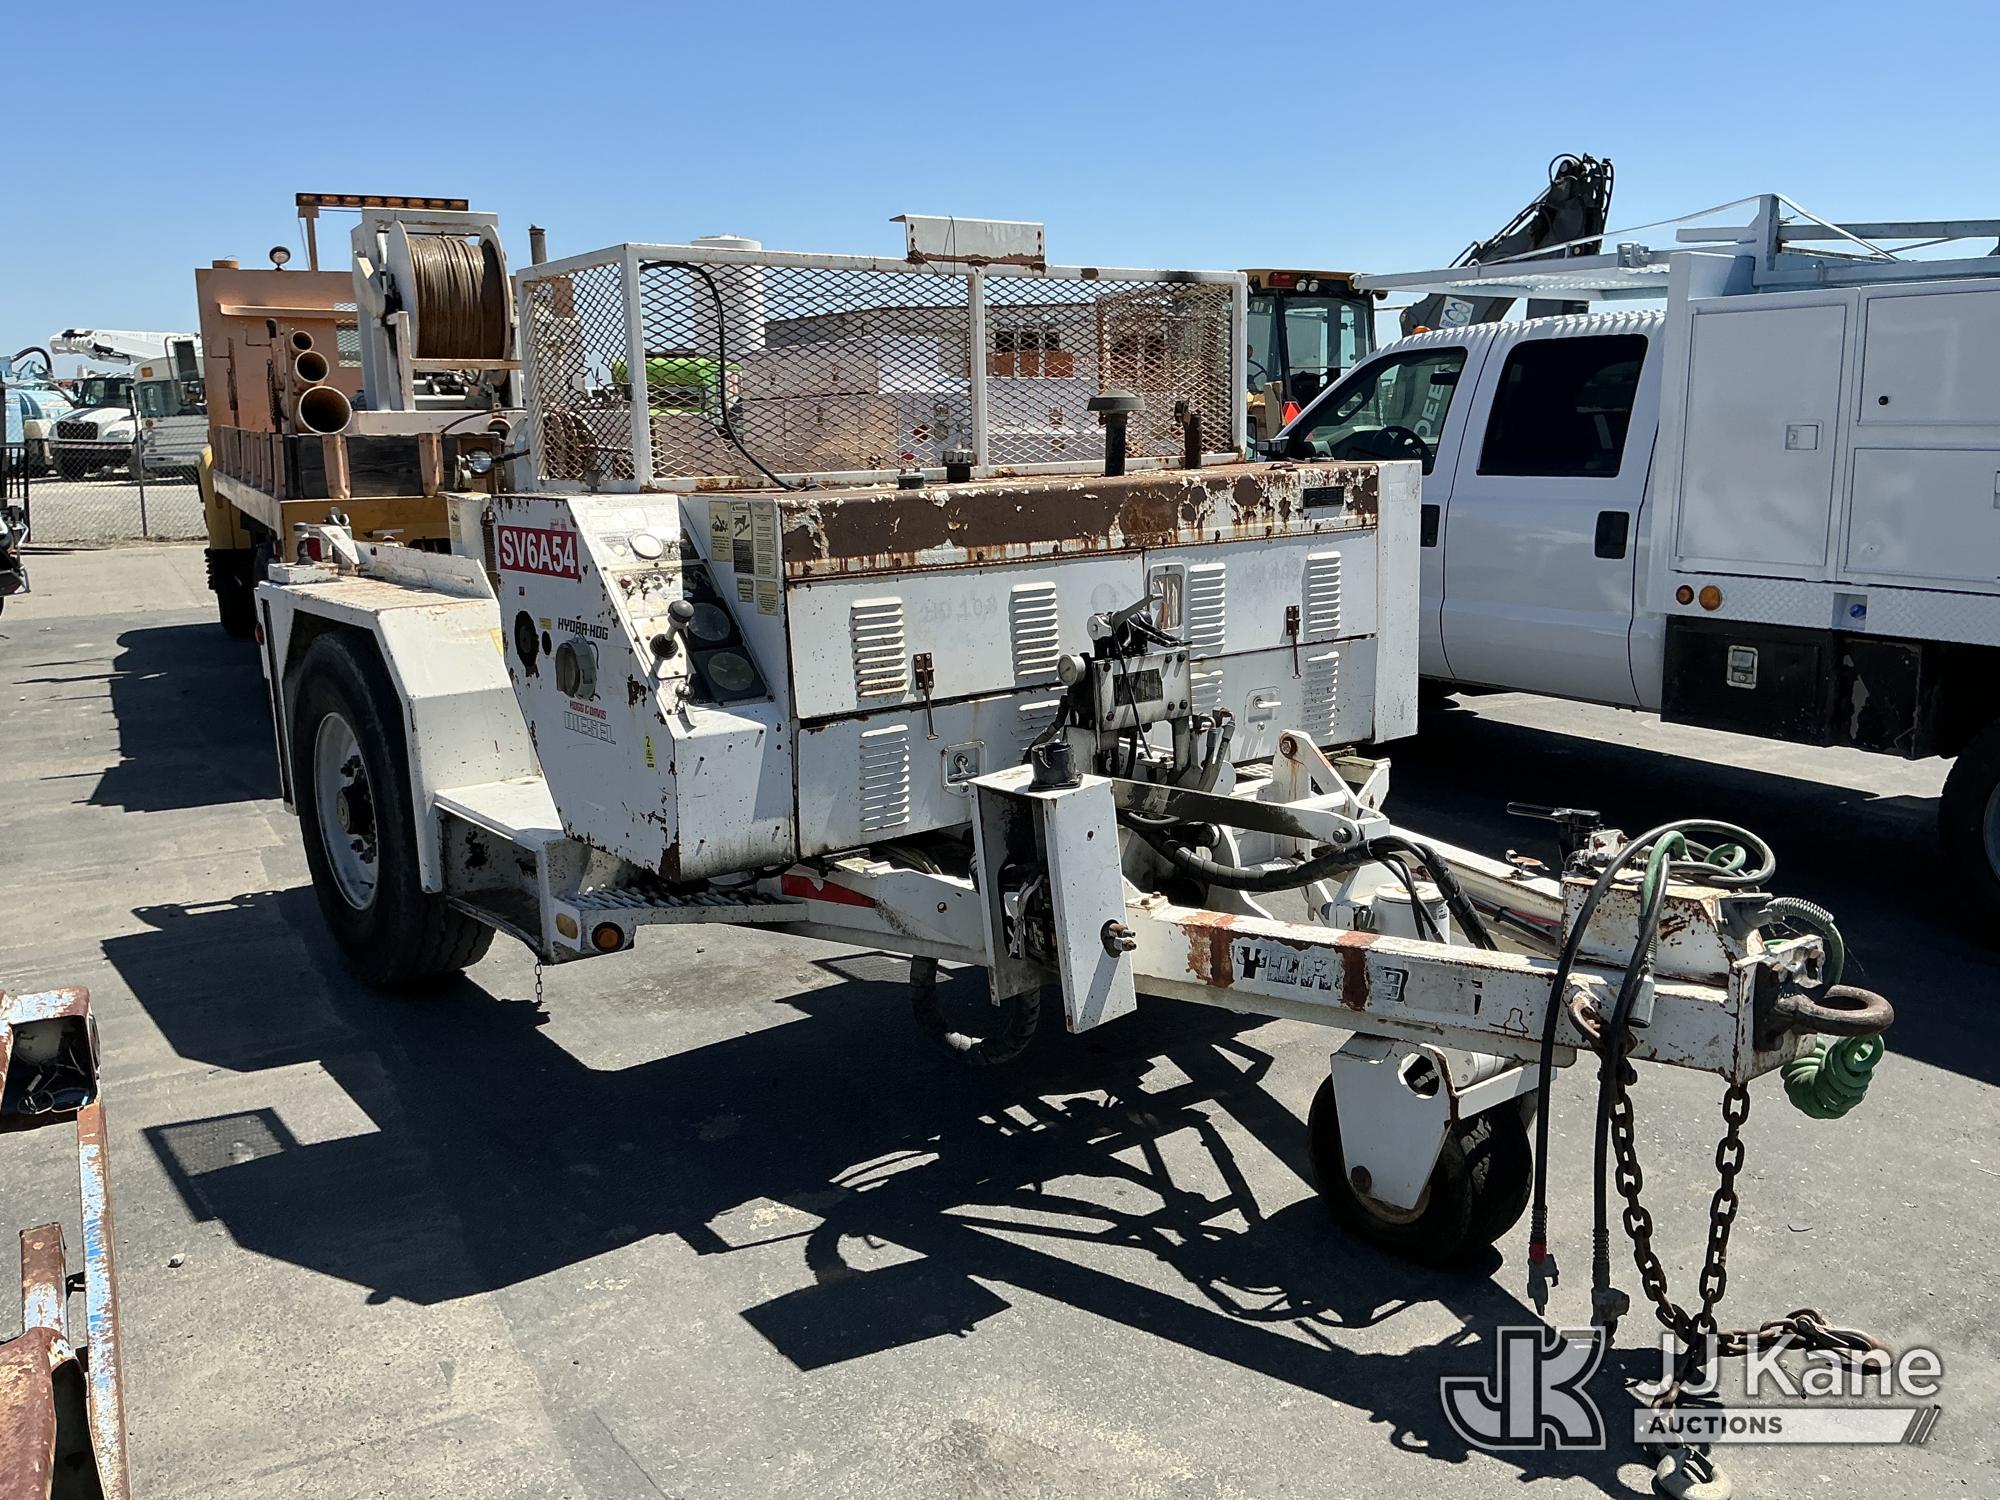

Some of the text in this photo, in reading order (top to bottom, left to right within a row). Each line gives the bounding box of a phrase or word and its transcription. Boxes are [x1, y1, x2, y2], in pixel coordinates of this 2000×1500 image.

[501, 529, 576, 574] SV6A54
[557, 616, 609, 640] HYDRA-HOG
[564, 710, 617, 746] DIESEL
